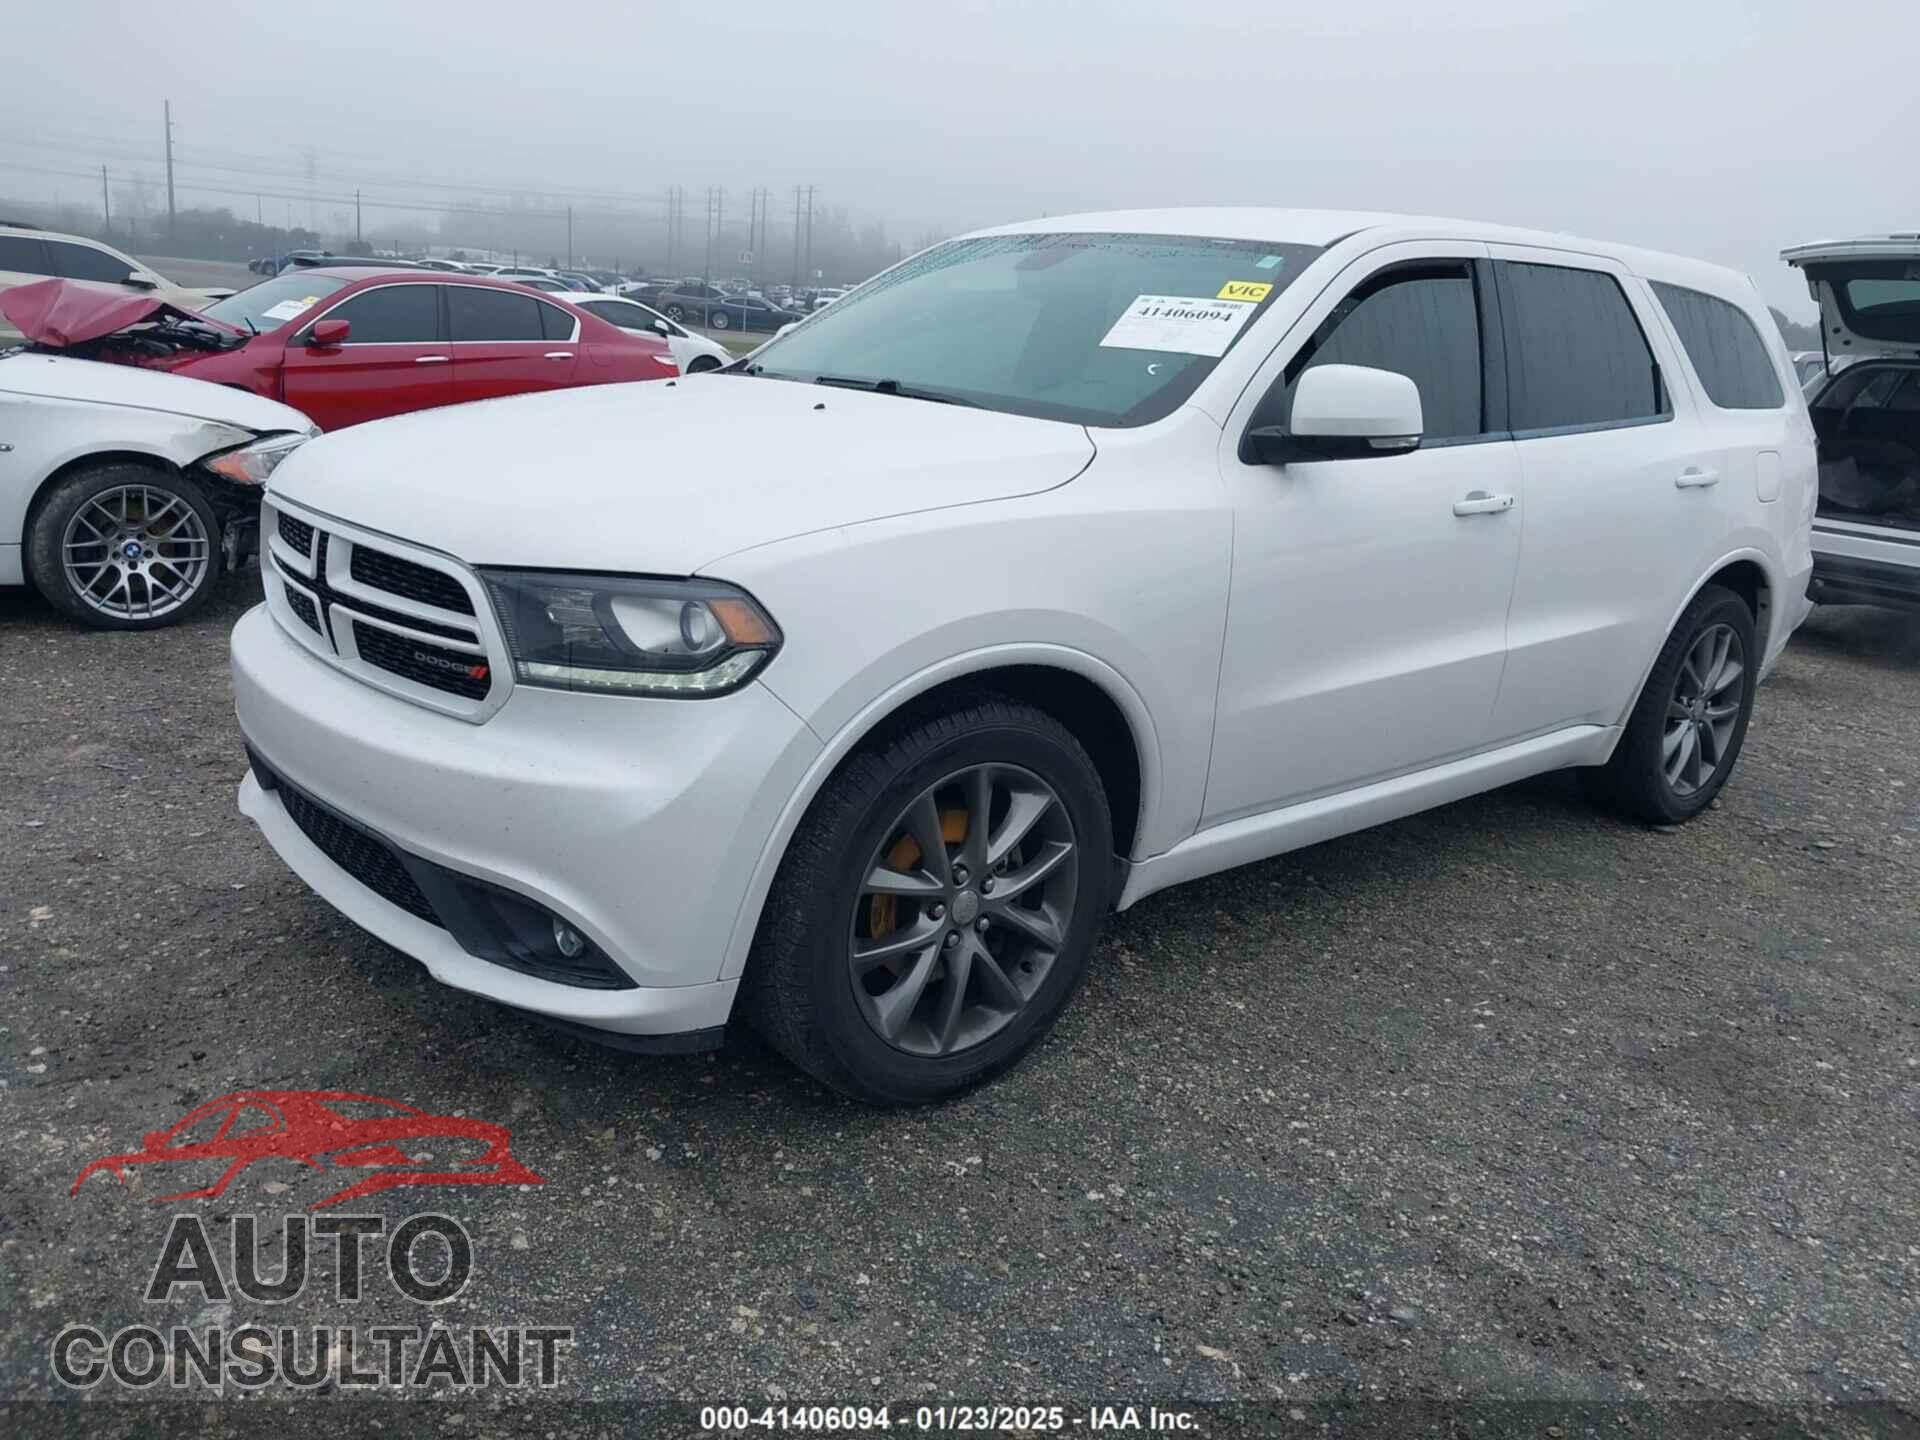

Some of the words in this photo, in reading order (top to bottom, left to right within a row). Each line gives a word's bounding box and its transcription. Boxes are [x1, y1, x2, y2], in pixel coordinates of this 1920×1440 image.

[1228, 284, 1265, 297] VIC
[1138, 307, 1232, 322] 41406094
[414, 651, 473, 674] DODGE
